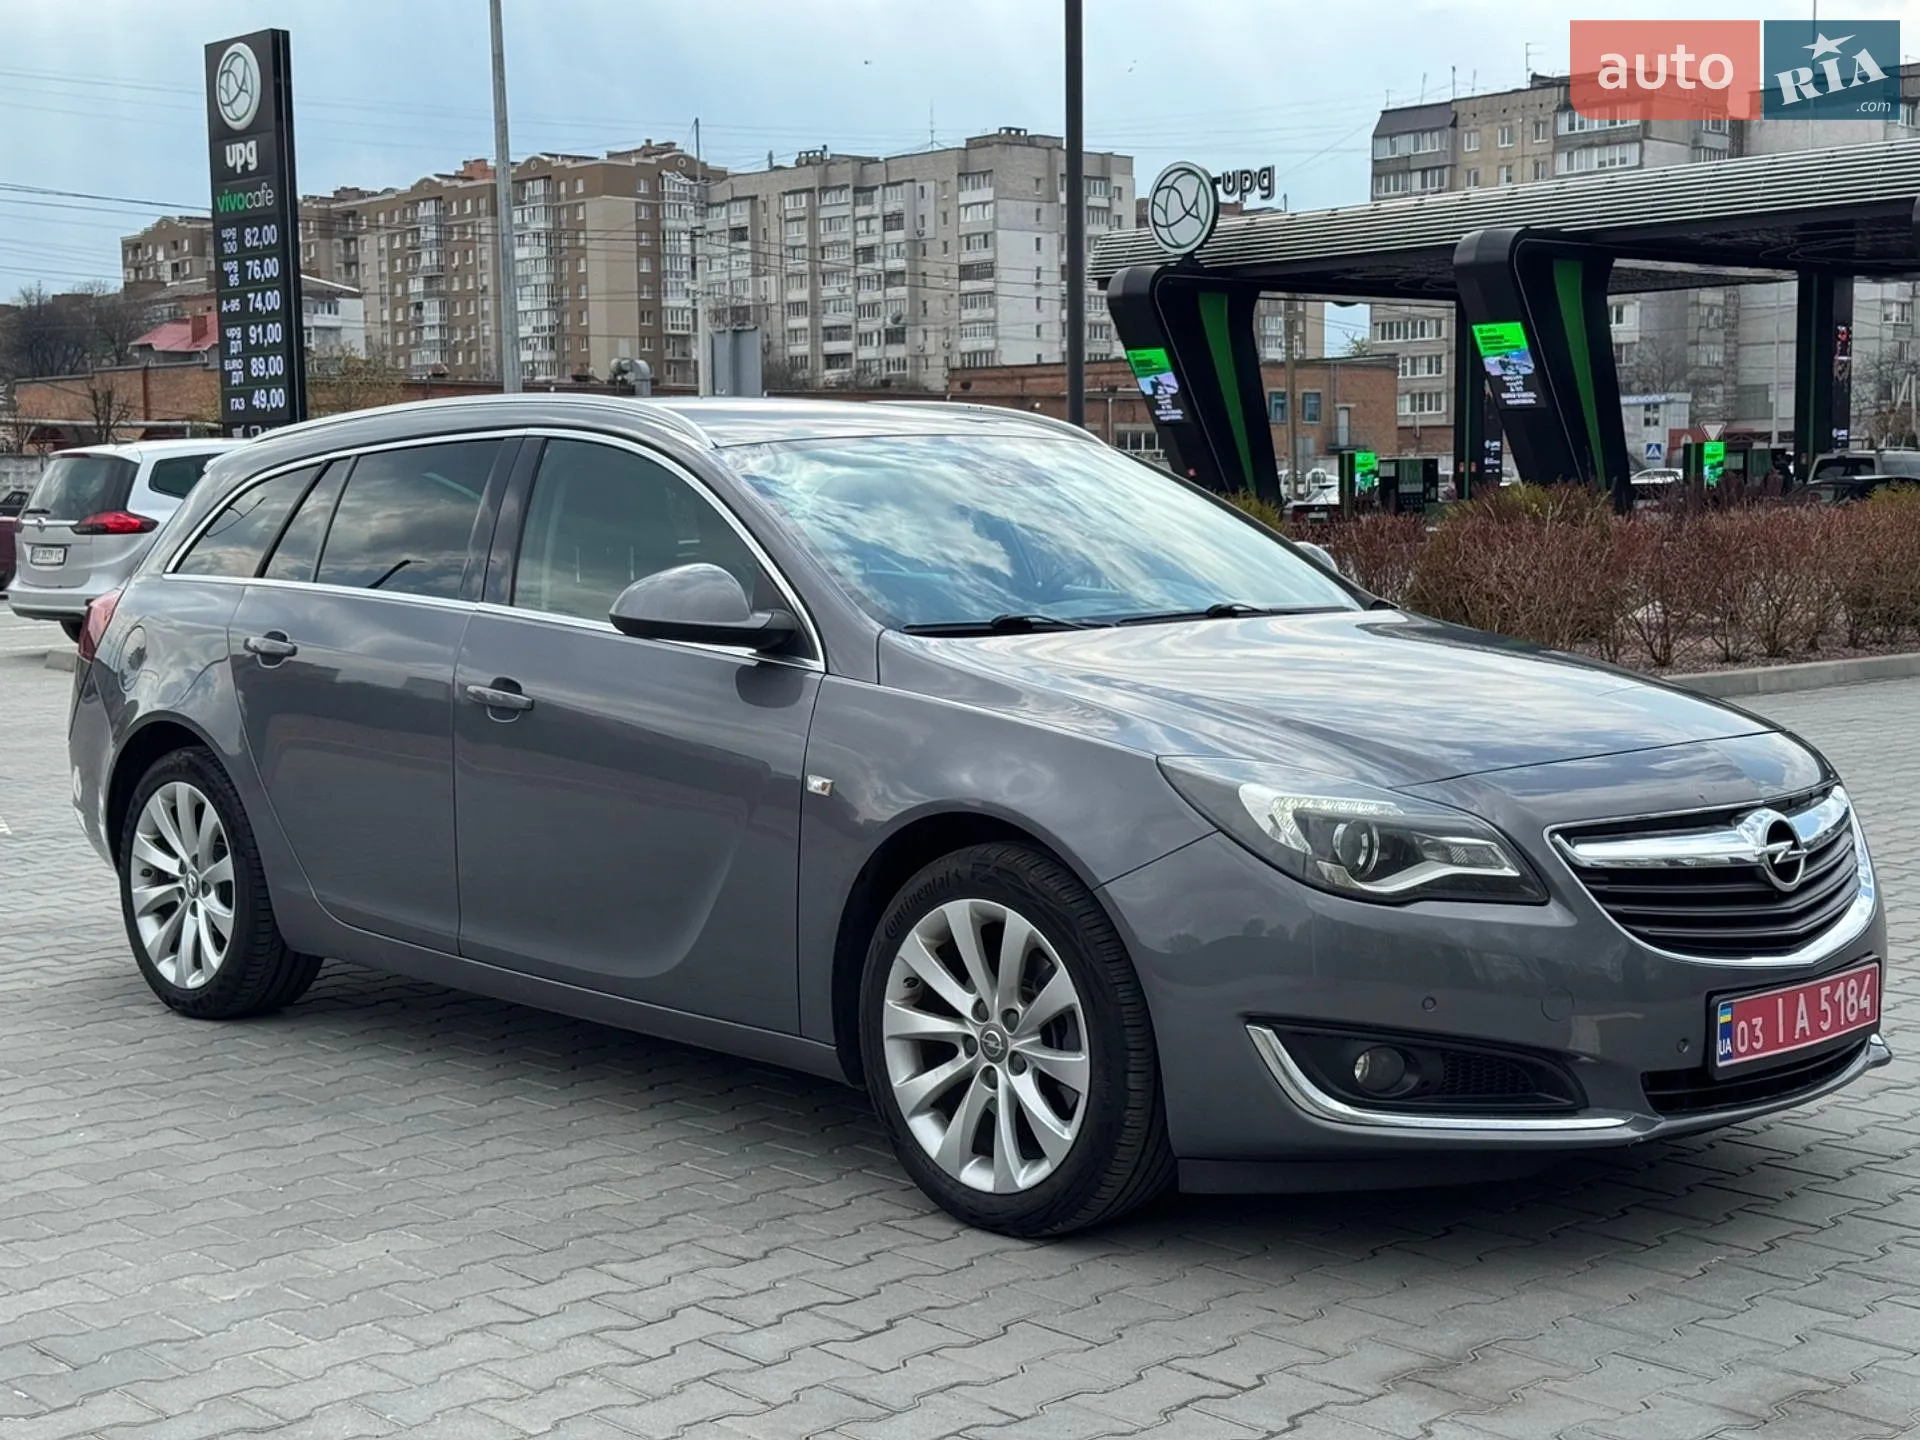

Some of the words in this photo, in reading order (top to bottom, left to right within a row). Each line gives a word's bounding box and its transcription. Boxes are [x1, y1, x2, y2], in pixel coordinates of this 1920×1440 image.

[225, 140, 258, 174] upg
[1222, 165, 1275, 203] upg
[221, 227, 237, 240] upg
[244, 224, 278, 250] 82,00
[223, 241, 238, 254] 100
[223, 260, 239, 274] upg
[245, 257, 280, 282] 76,00
[229, 274, 240, 287] 95
[247, 290, 281, 315] 74,00
[226, 326, 242, 339] upg
[249, 322, 282, 347] 91,00
[224, 358, 244, 371] EURO
[250, 355, 284, 380] 89,00
[230, 397, 246, 411] ГАЗ
[252, 388, 286, 412] 49,00
[1736, 1016, 1764, 1053] 03
[1718, 1039, 1732, 1055] UA
